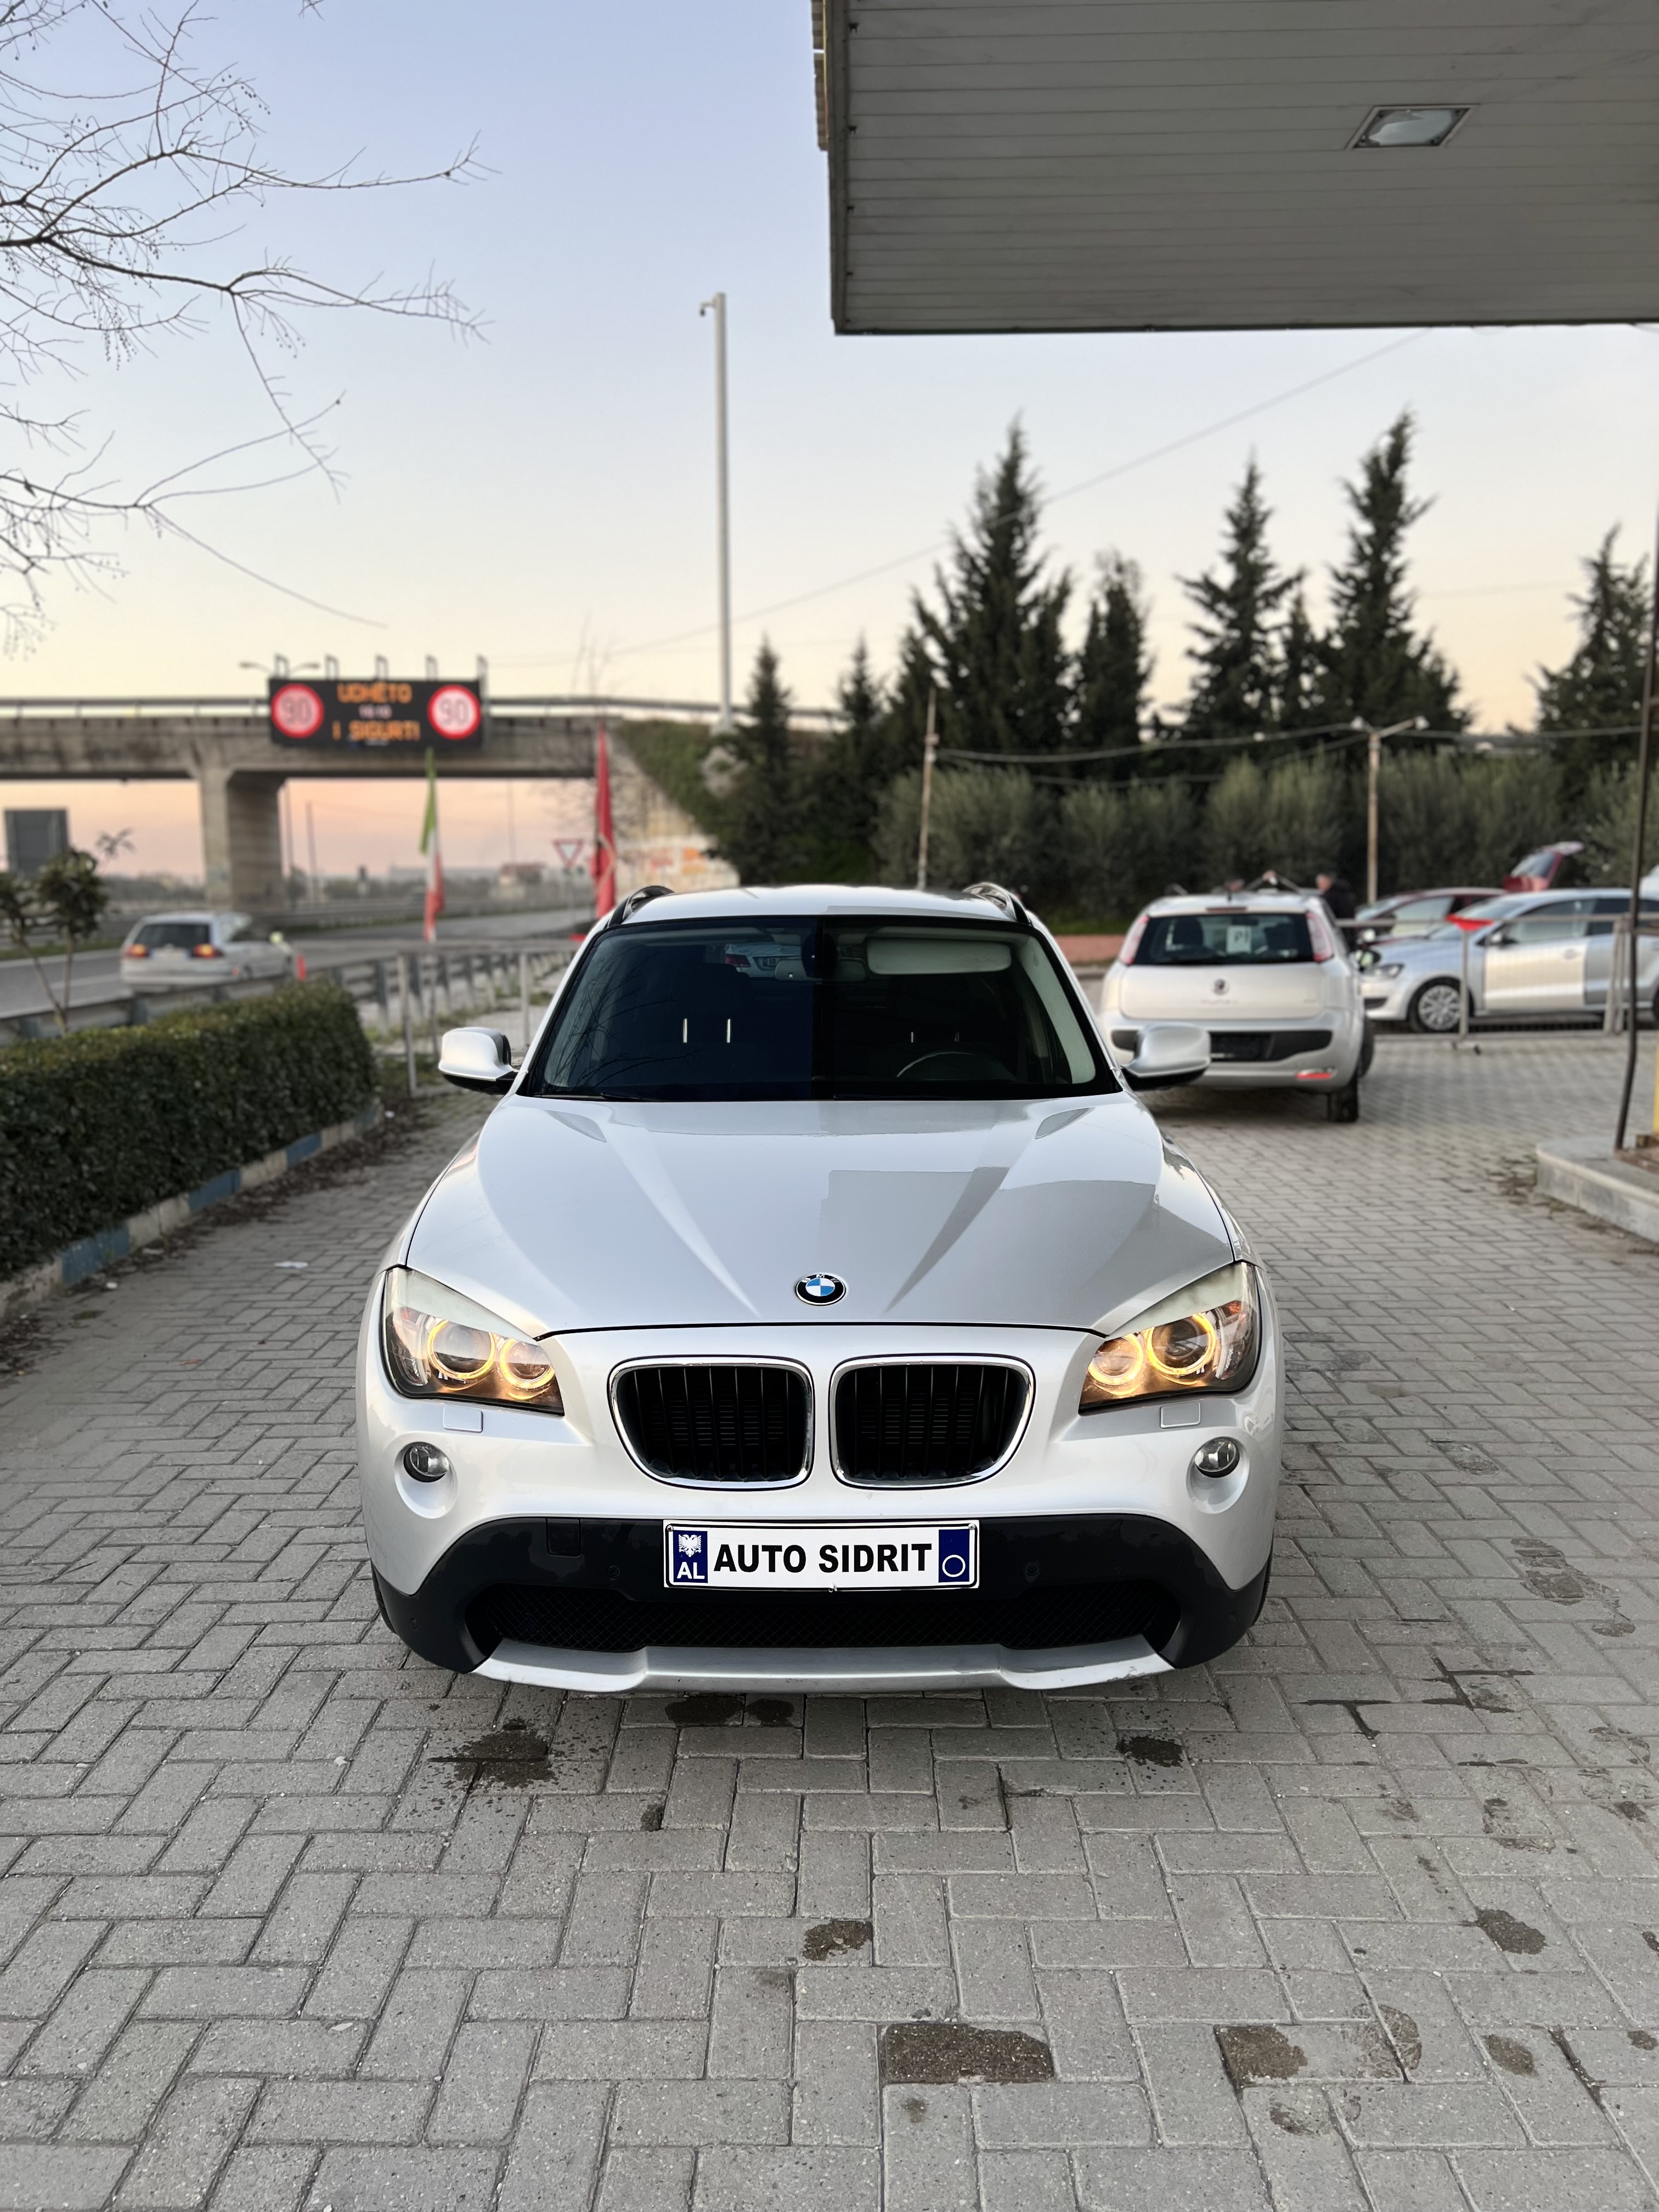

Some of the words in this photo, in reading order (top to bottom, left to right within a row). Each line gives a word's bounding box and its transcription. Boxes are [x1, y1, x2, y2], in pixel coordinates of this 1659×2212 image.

[280, 696, 312, 725] 90
[439, 698, 470, 726] 90
[801, 1274, 839, 1283] BMW
[677, 1561, 705, 1579] AL
[714, 1544, 806, 1573] AUTO
[819, 1543, 932, 1573] SIDRIT
